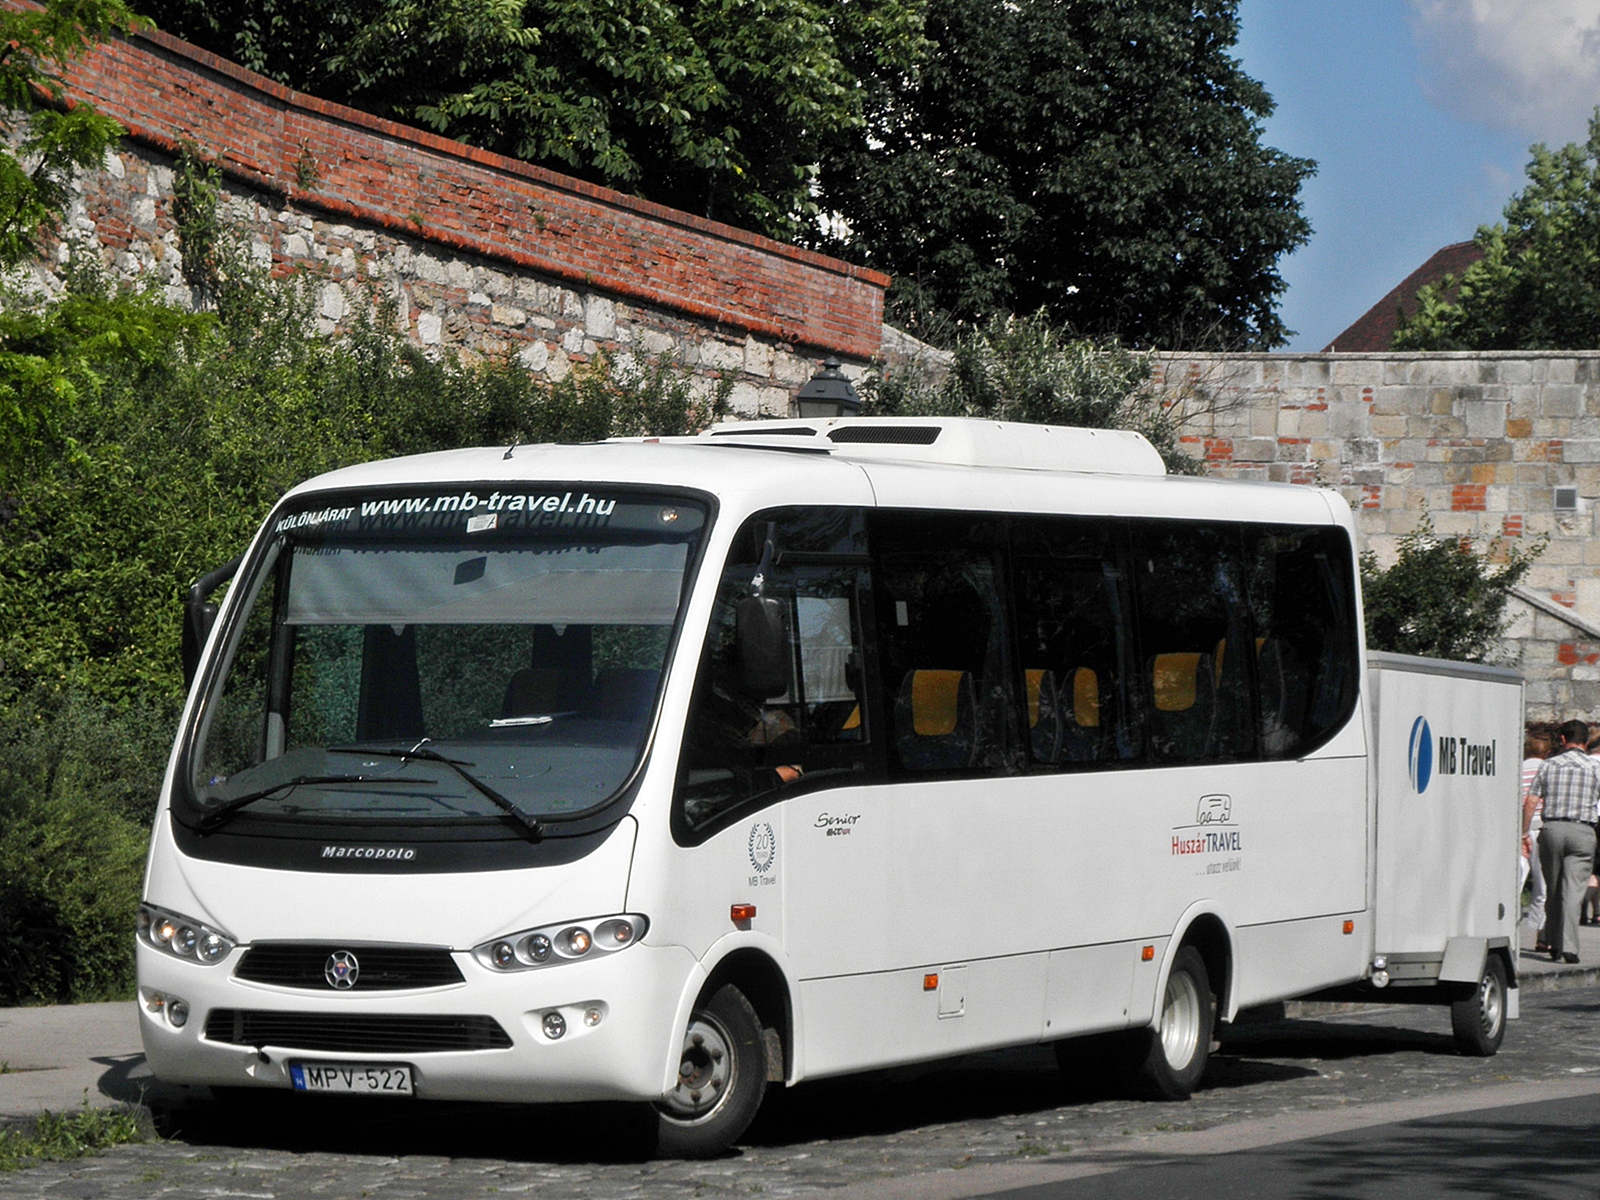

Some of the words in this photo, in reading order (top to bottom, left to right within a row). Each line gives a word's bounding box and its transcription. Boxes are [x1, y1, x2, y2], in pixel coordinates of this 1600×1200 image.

[361, 491, 616, 517] www.mb-travel.hu
[1439, 736, 1457, 775] MB
[1460, 737, 1496, 777] Travel
[814, 812, 861, 828] Senior
[756, 834, 769, 850] 20
[1171, 832, 1242, 855] HuszárTRAVEL
[322, 846, 414, 860] Marcopolo
[748, 876, 758, 887] MB
[759, 875, 776, 886] Travel
[307, 1066, 408, 1091] MPV-522
